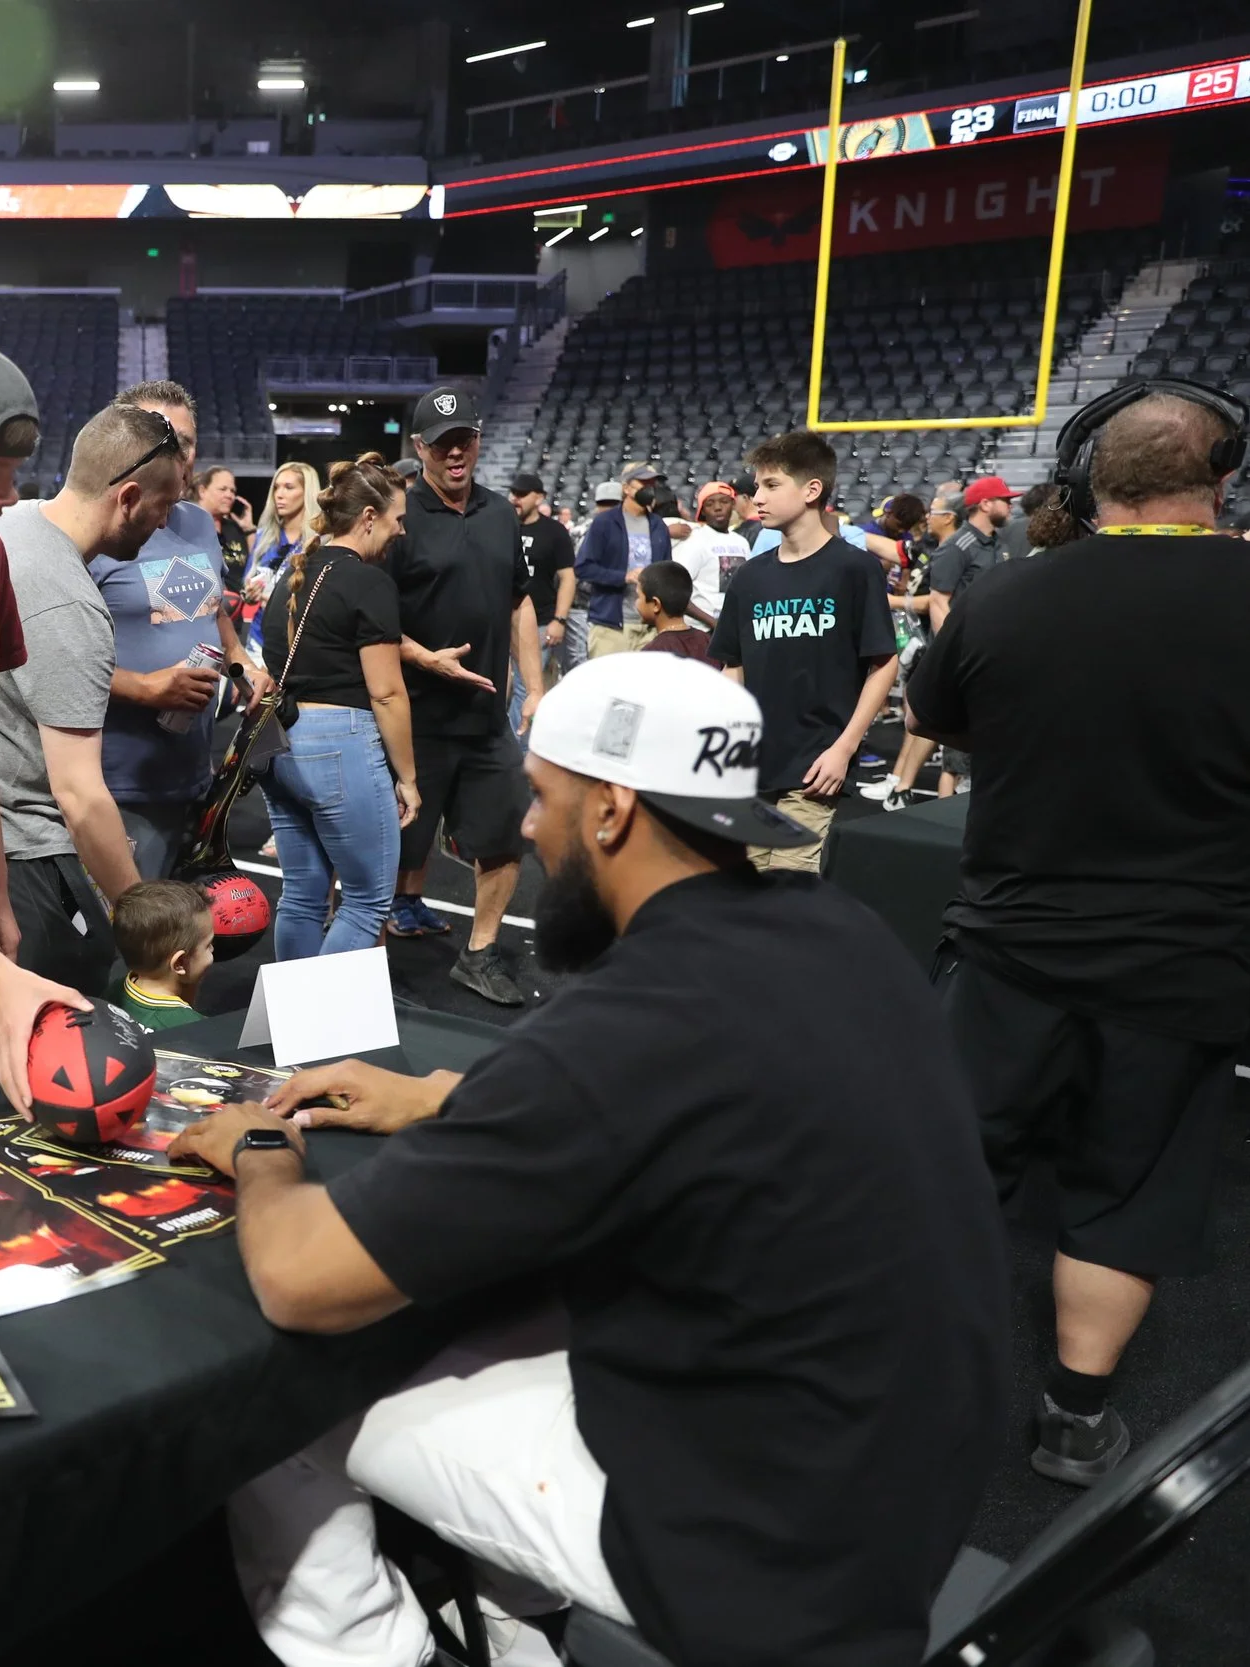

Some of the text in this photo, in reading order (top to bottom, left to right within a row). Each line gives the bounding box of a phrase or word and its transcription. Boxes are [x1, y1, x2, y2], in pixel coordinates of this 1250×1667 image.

[1191, 68, 1235, 98] 25
[1091, 83, 1157, 113] 0:00
[950, 104, 995, 136] 23
[1017, 105, 1057, 124] FINAL
[848, 167, 1116, 234] KNIGHT
[167, 581, 205, 594] HURLEY
[753, 598, 835, 619] SANTA'S
[752, 613, 836, 641] WRAP
